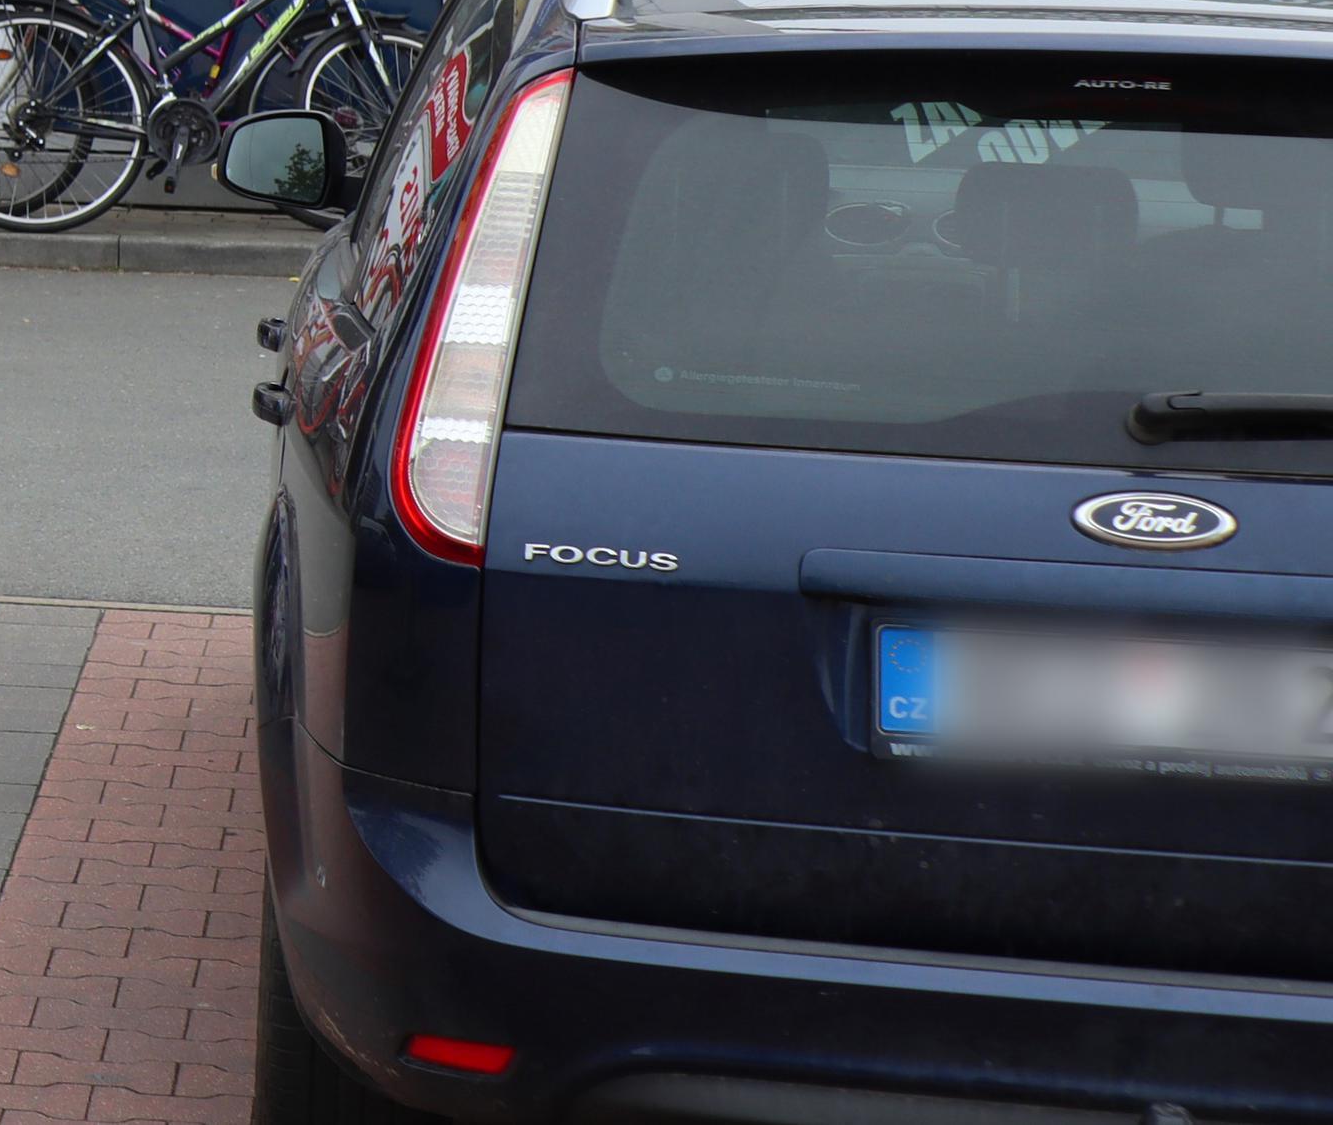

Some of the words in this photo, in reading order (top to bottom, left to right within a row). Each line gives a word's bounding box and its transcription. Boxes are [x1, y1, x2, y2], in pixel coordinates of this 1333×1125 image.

[1073, 78, 1172, 92] AUTO-RE
[1111, 501, 1199, 534] Ford
[523, 541, 681, 572] FOCUS
[887, 694, 929, 721] CZ
